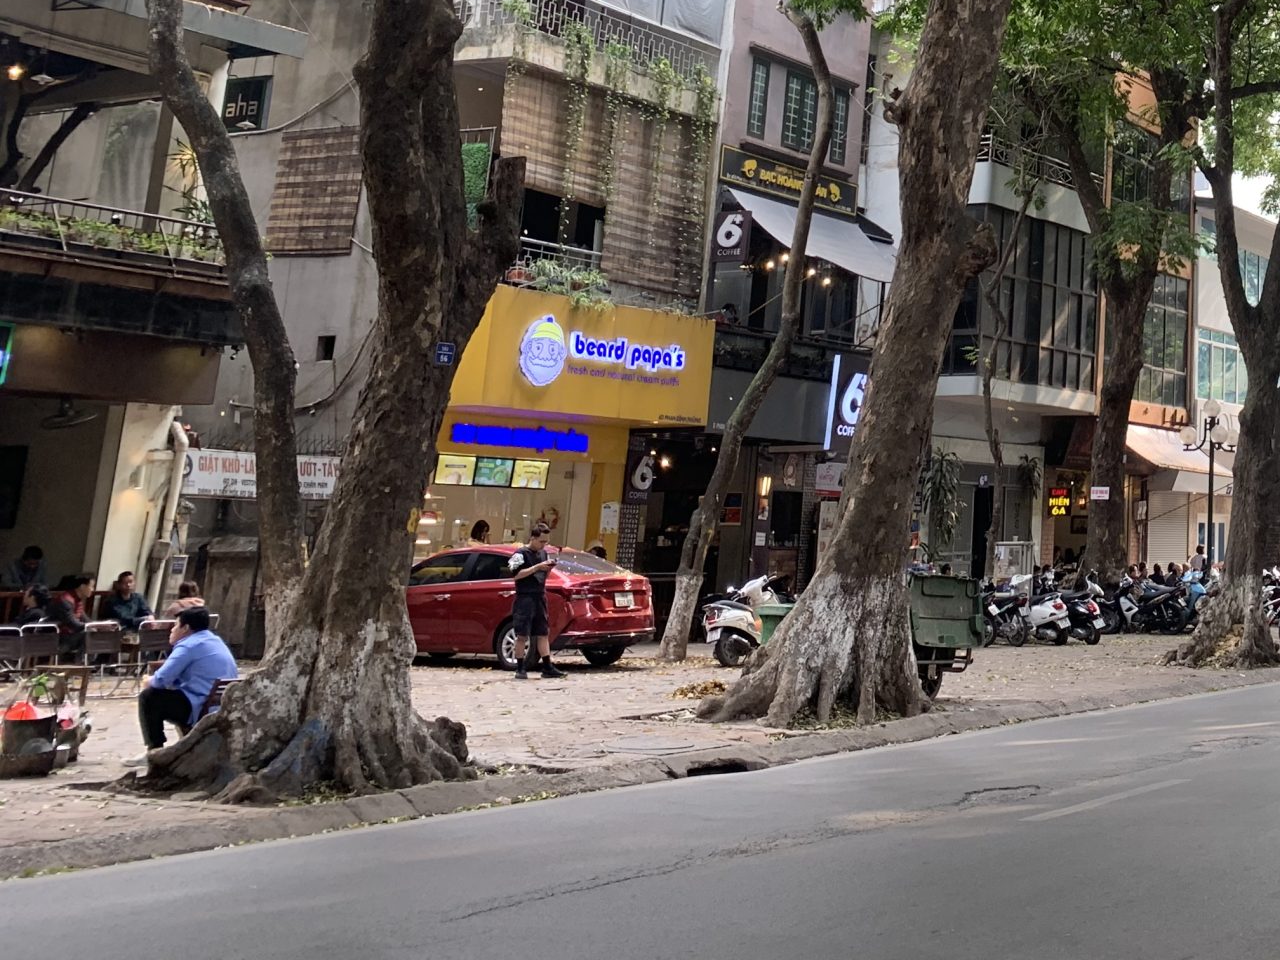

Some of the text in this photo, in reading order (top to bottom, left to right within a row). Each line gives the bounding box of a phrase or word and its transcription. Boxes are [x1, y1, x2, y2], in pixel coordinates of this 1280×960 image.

[225, 93, 258, 117] aha
[760, 168, 777, 185] BẠC
[717, 248, 741, 256] COFFEE
[574, 333, 684, 369] beard papa's
[567, 366, 588, 376] fresh
[590, 368, 605, 378] and
[607, 371, 635, 382] natural
[637, 375, 660, 384] cream
[198, 454, 218, 475] GIẶT
[1052, 506, 1066, 515] 6A
